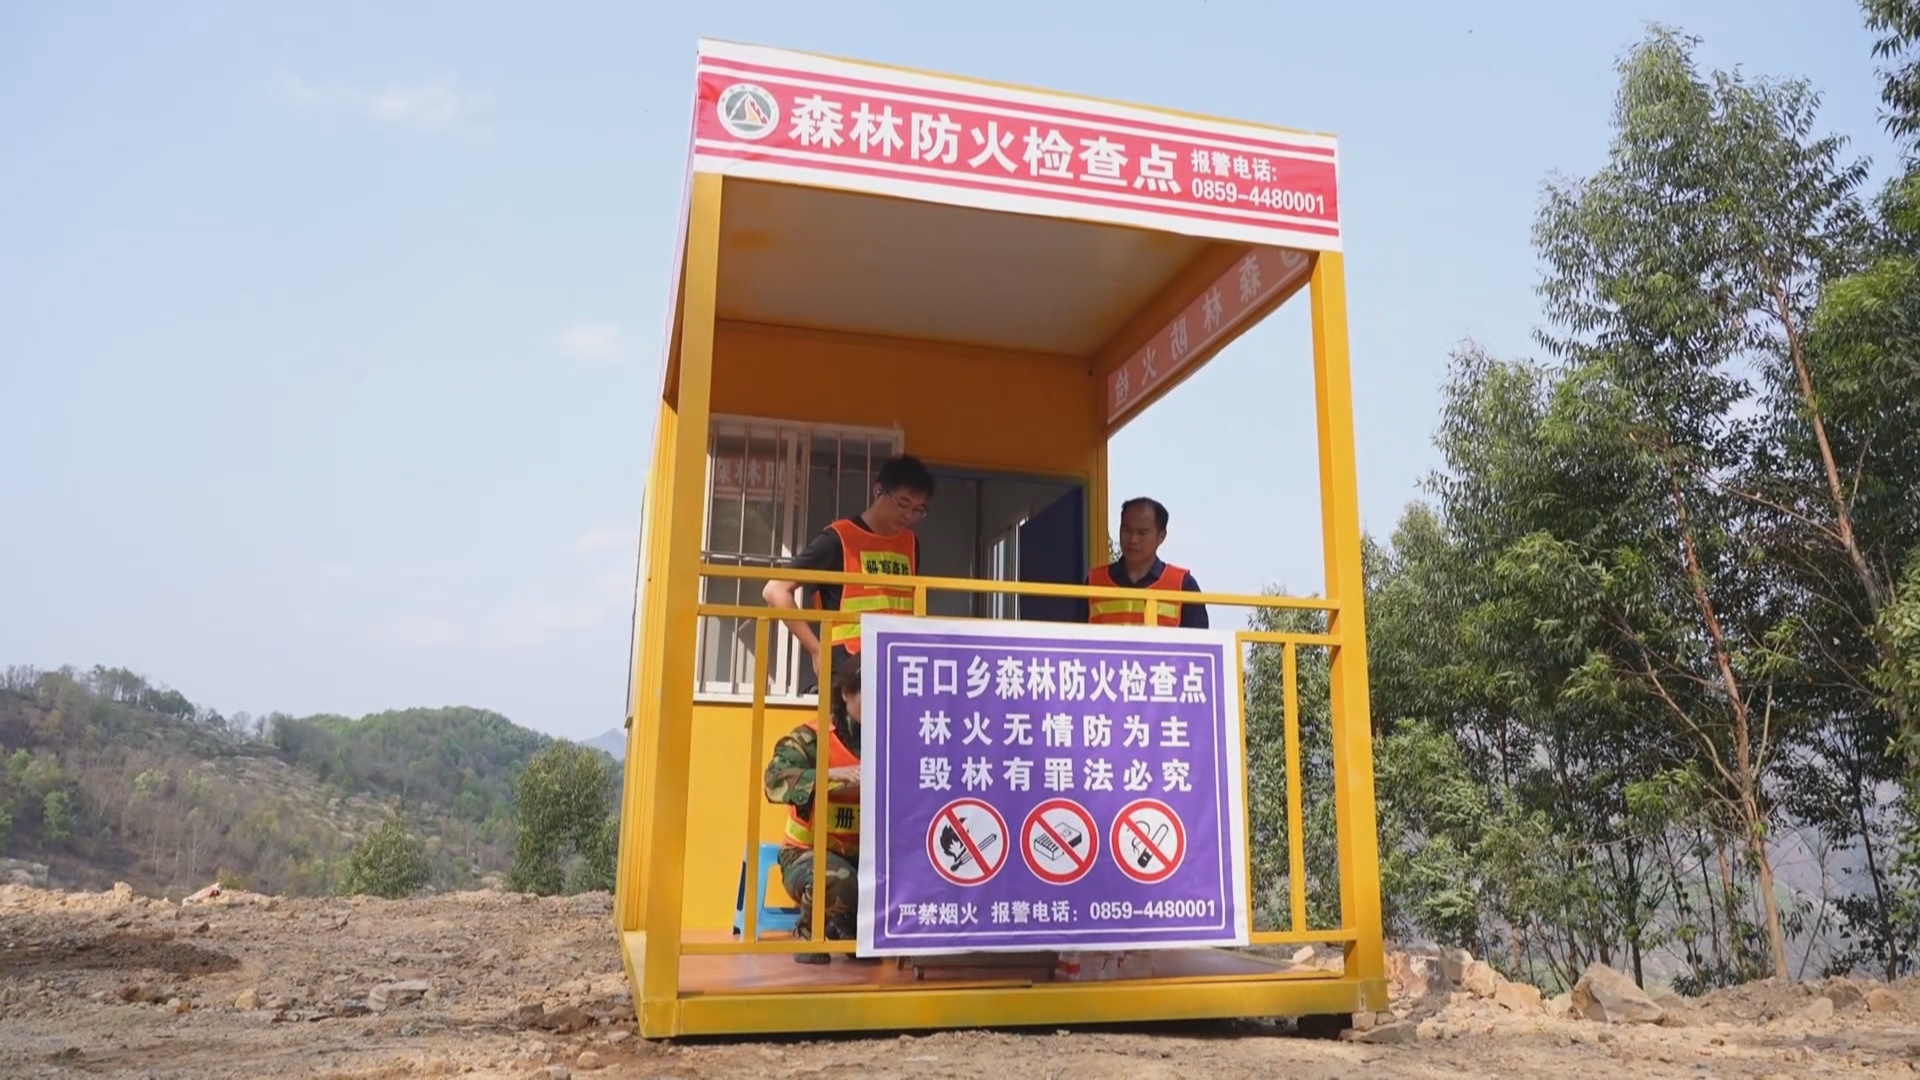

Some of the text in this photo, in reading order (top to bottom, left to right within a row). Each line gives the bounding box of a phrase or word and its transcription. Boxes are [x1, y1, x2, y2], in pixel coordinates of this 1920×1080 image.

[788, 95, 1182, 194] 森林防火检查点
[1191, 176, 1325, 216] 0859-4480001
[897, 655, 1207, 703] 百口乡森林防火检查点
[919, 710, 1190, 748] 林火无情防为主
[919, 756, 1192, 792] 毁林有罪法必究
[897, 902, 979, 926] 严禁烟火
[1089, 899, 1216, 920] 0859-4480001
